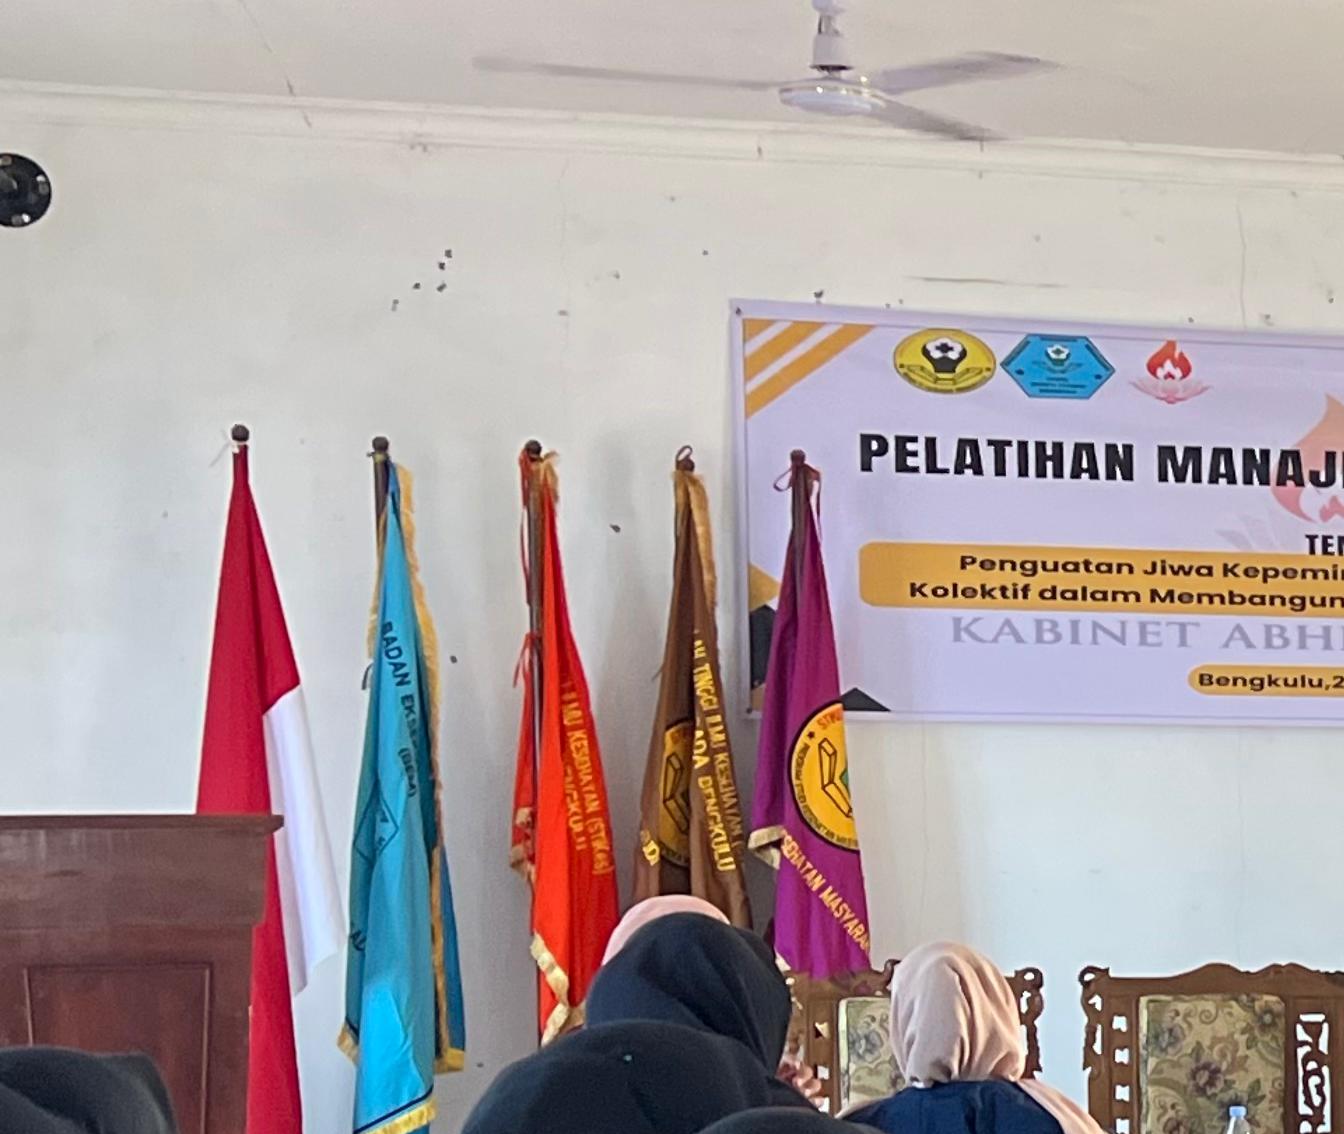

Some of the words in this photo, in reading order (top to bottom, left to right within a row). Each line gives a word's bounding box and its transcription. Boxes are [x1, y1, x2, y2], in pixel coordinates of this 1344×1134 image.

[860, 434, 1133, 481] PELATIHAN
[960, 556, 1134, 577] Penguatan
[1143, 560, 1213, 577] Jiwa
[910, 583, 1030, 599] Kolektif
[1039, 585, 1141, 602] dalam
[951, 616, 1200, 649] KABINET
[382, 621, 411, 687] BADAN
[781, 830, 826, 892] SEHATAN
